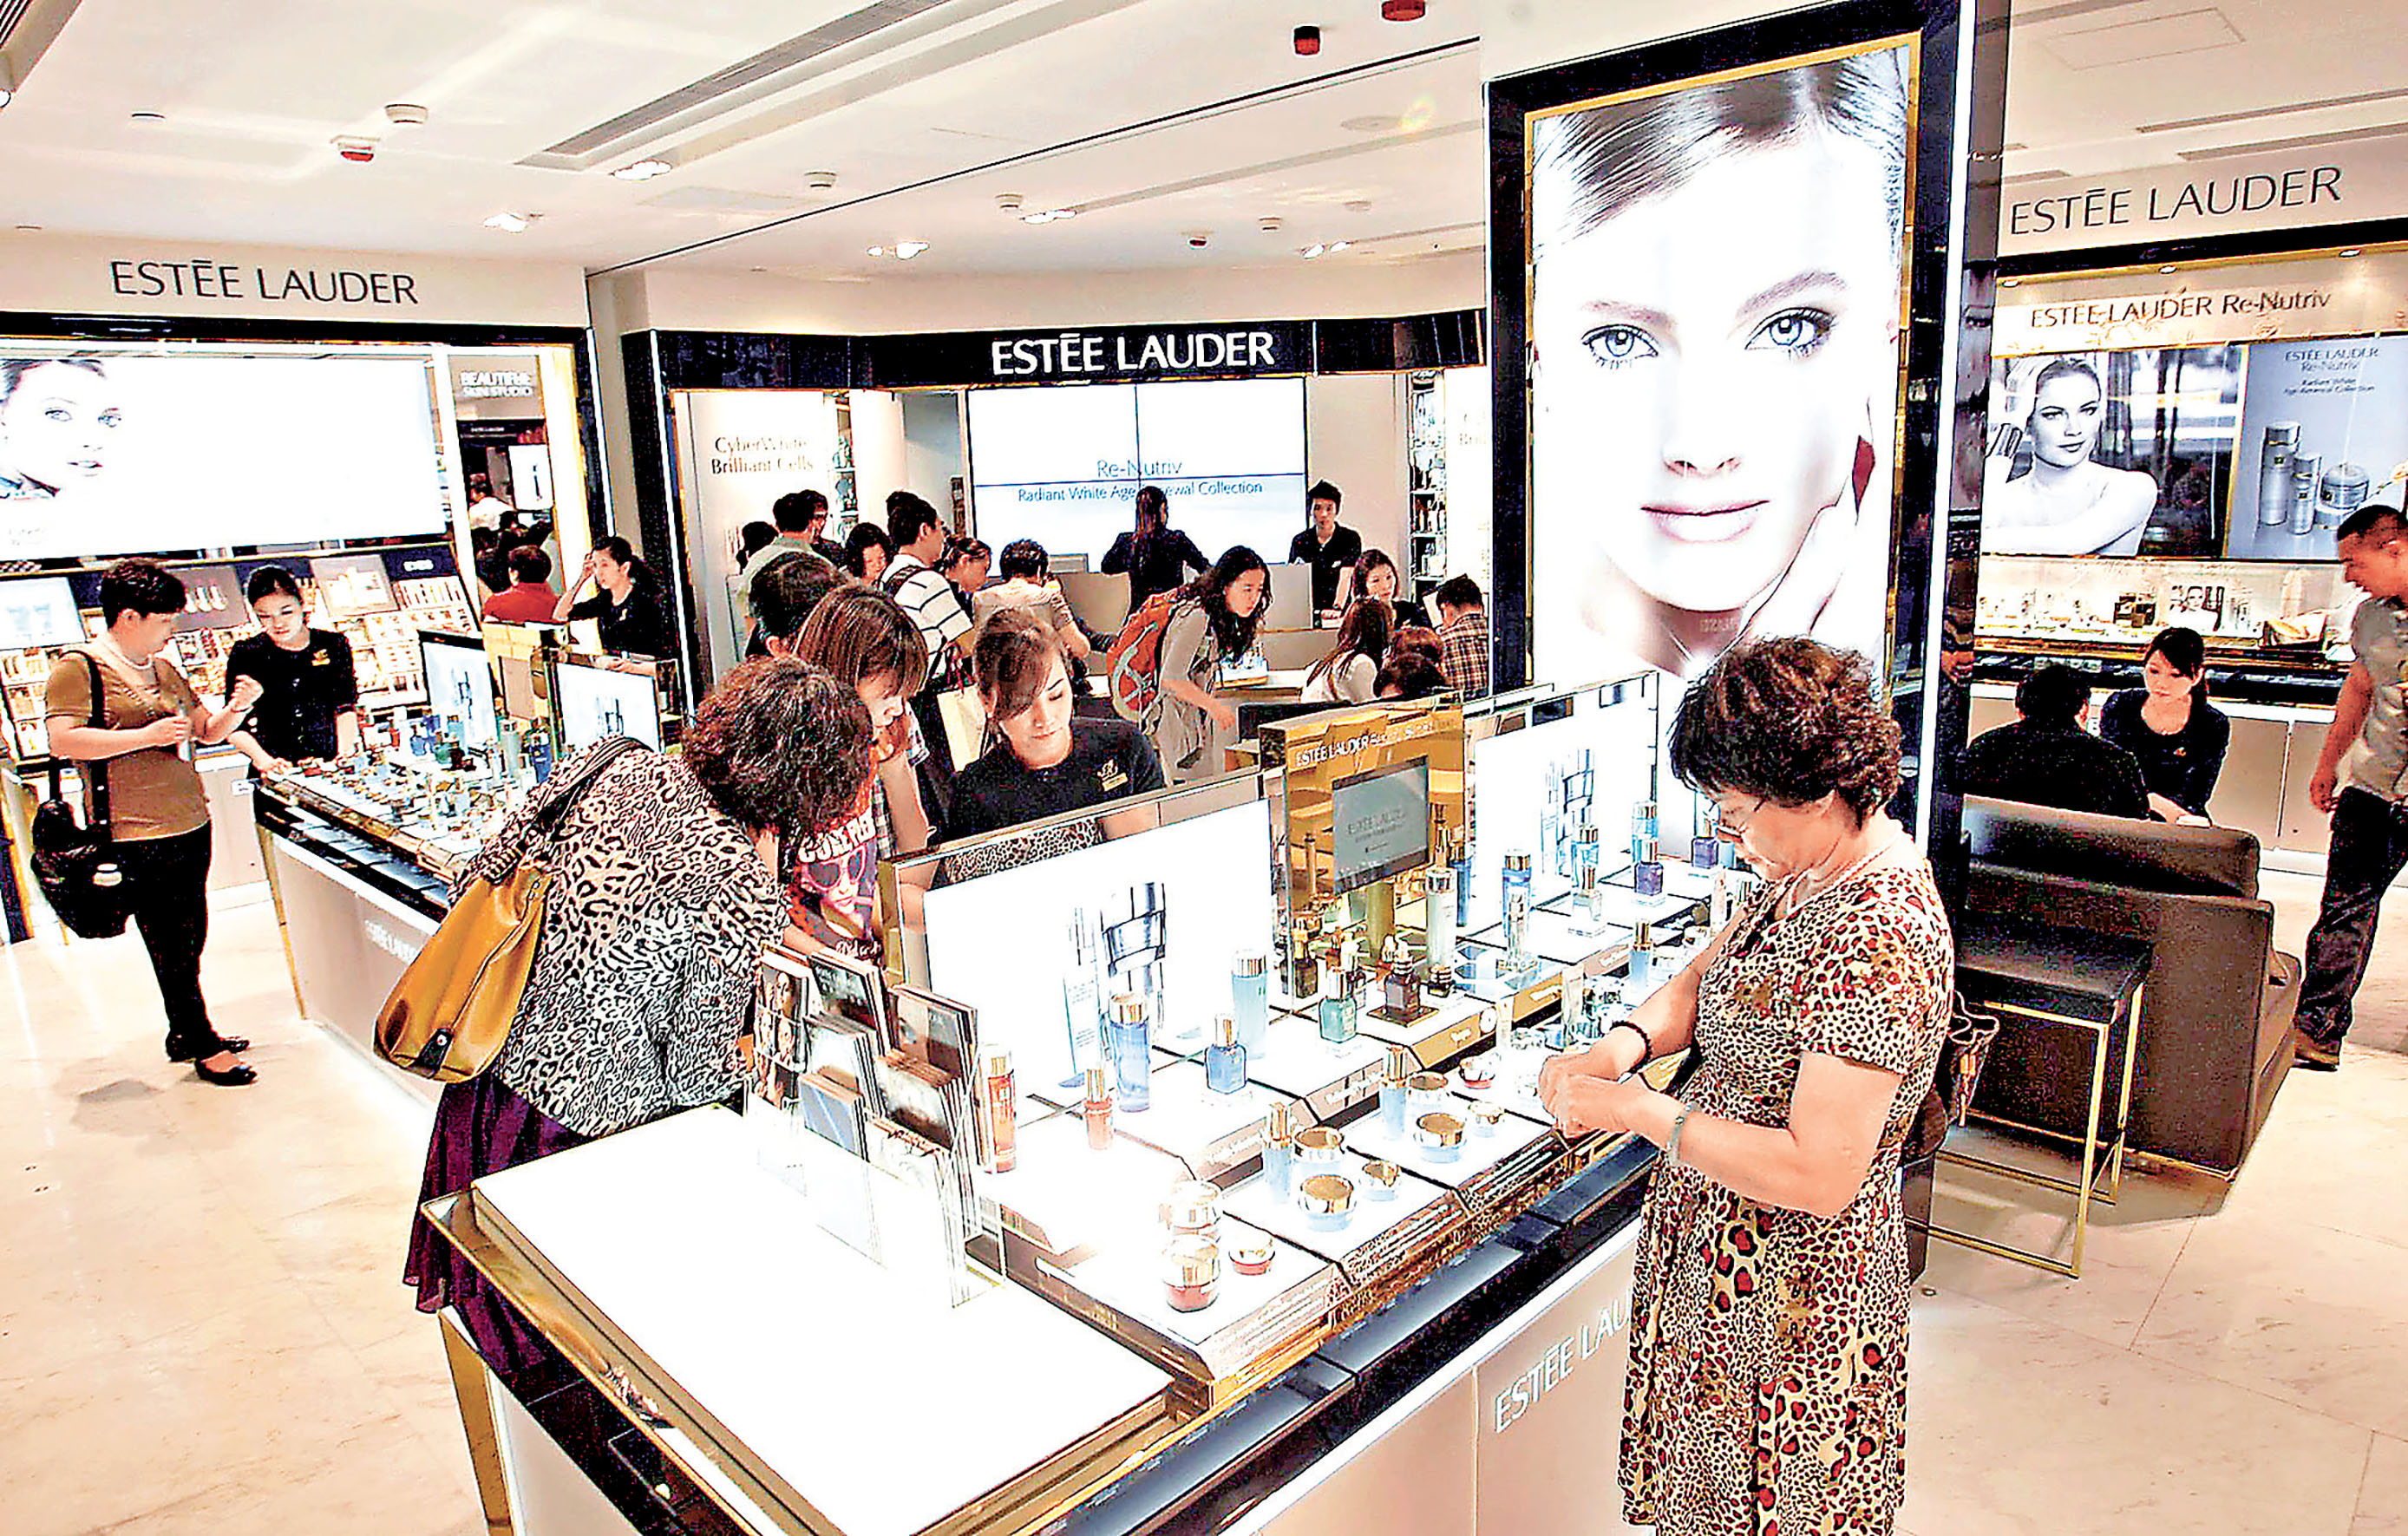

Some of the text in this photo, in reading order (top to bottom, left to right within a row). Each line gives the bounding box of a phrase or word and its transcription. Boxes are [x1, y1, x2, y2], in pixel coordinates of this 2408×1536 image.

[2149, 167, 2342, 221] LAUDER
[257, 267, 418, 304] LAUDER
[2104, 296, 2212, 323] LAUDER
[2222, 291, 2331, 316] Re-Nutriv
[1117, 331, 1275, 371] LAUDER
[1096, 459, 1183, 478] Re-Nutriv
[1018, 487, 1065, 502] Radiant
[1069, 487, 1107, 500] White
[1198, 480, 1264, 495] Collection
[1580, 1287, 1633, 1361] LAU
